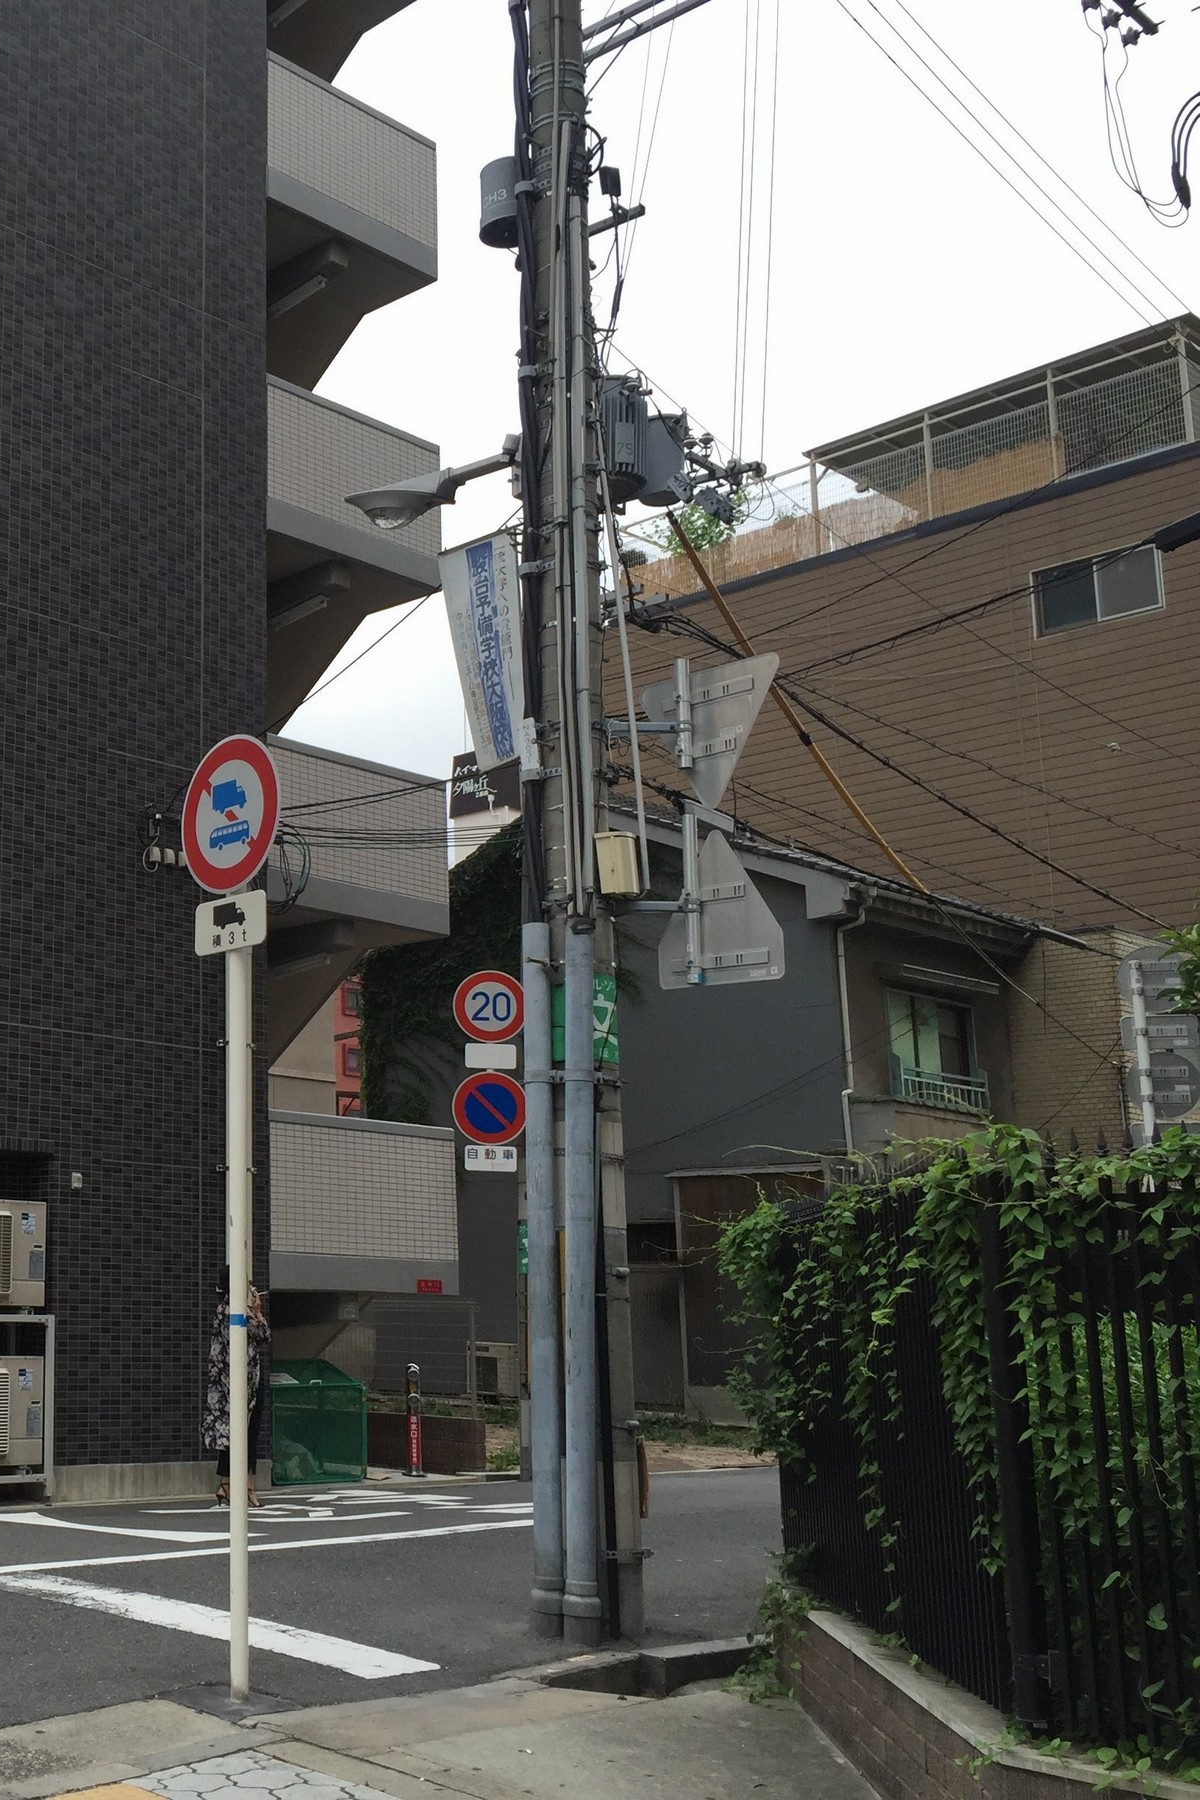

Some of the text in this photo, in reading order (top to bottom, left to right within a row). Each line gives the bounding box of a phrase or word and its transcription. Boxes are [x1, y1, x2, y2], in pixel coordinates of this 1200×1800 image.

[617, 442, 633, 456] 75
[471, 991, 511, 1022] 20
[467, 1148, 514, 1160] 自動車
